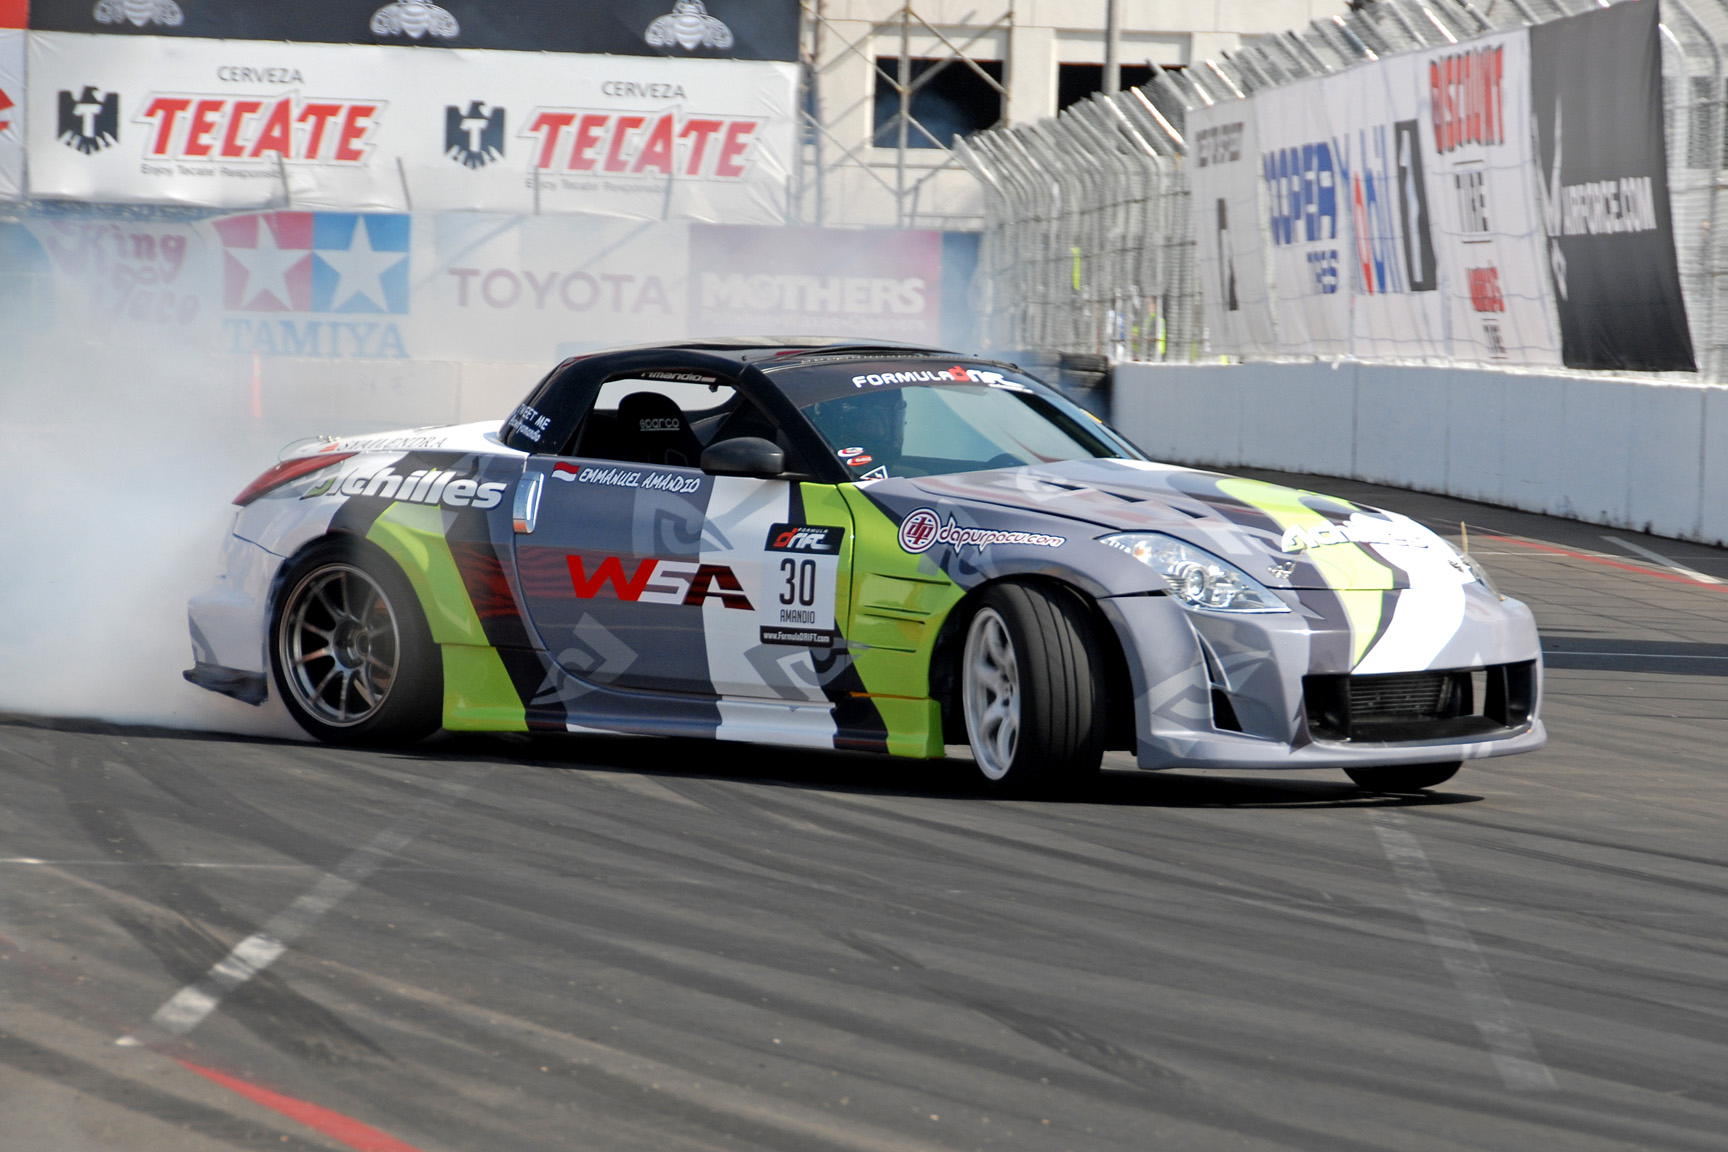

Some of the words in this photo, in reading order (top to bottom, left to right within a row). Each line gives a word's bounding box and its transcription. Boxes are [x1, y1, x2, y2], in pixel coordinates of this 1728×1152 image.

[217, 65, 305, 85] CERVEZA
[601, 79, 687, 99] CERVEZA
[142, 96, 377, 162] TECATE
[529, 112, 757, 178] TECATE
[448, 267, 673, 315] TOYOTA
[701, 272, 926, 314] MOTHERS
[222, 317, 411, 359] TAMIYA
[852, 370, 954, 389] FORMULA
[534, 414, 551, 431] ME
[639, 417, 680, 430] sparco
[300, 467, 508, 509] Achilles
[578, 468, 641, 488] EMMANUEL
[641, 472, 701, 494] AMANDIO
[565, 555, 756, 611] WSA
[778, 557, 817, 607] 30
[779, 609, 816, 625] AMANDIO
